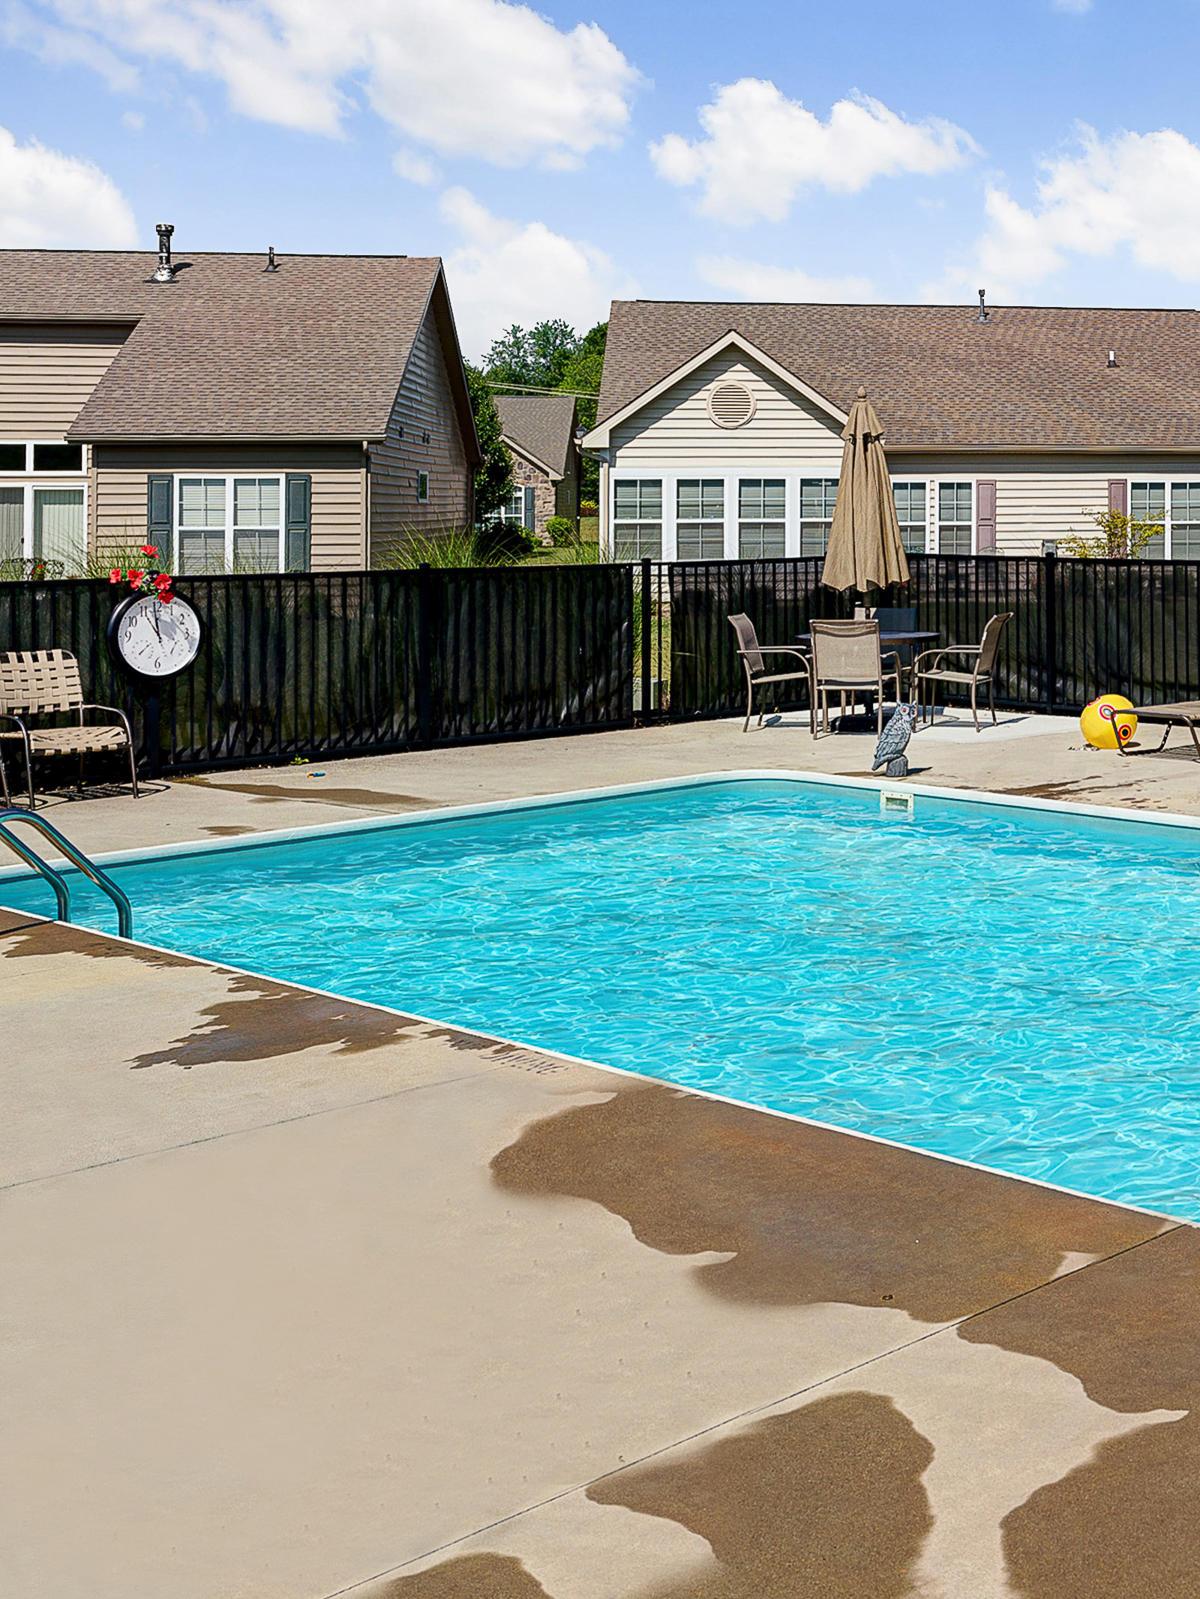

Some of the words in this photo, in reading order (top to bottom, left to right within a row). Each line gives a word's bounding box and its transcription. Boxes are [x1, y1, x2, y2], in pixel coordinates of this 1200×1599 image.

[128, 615, 137, 627] 10
[179, 613, 185, 625] 2
[125, 631, 131, 642] 9
[184, 627, 190, 640] 3
[154, 657, 160, 668] 6
